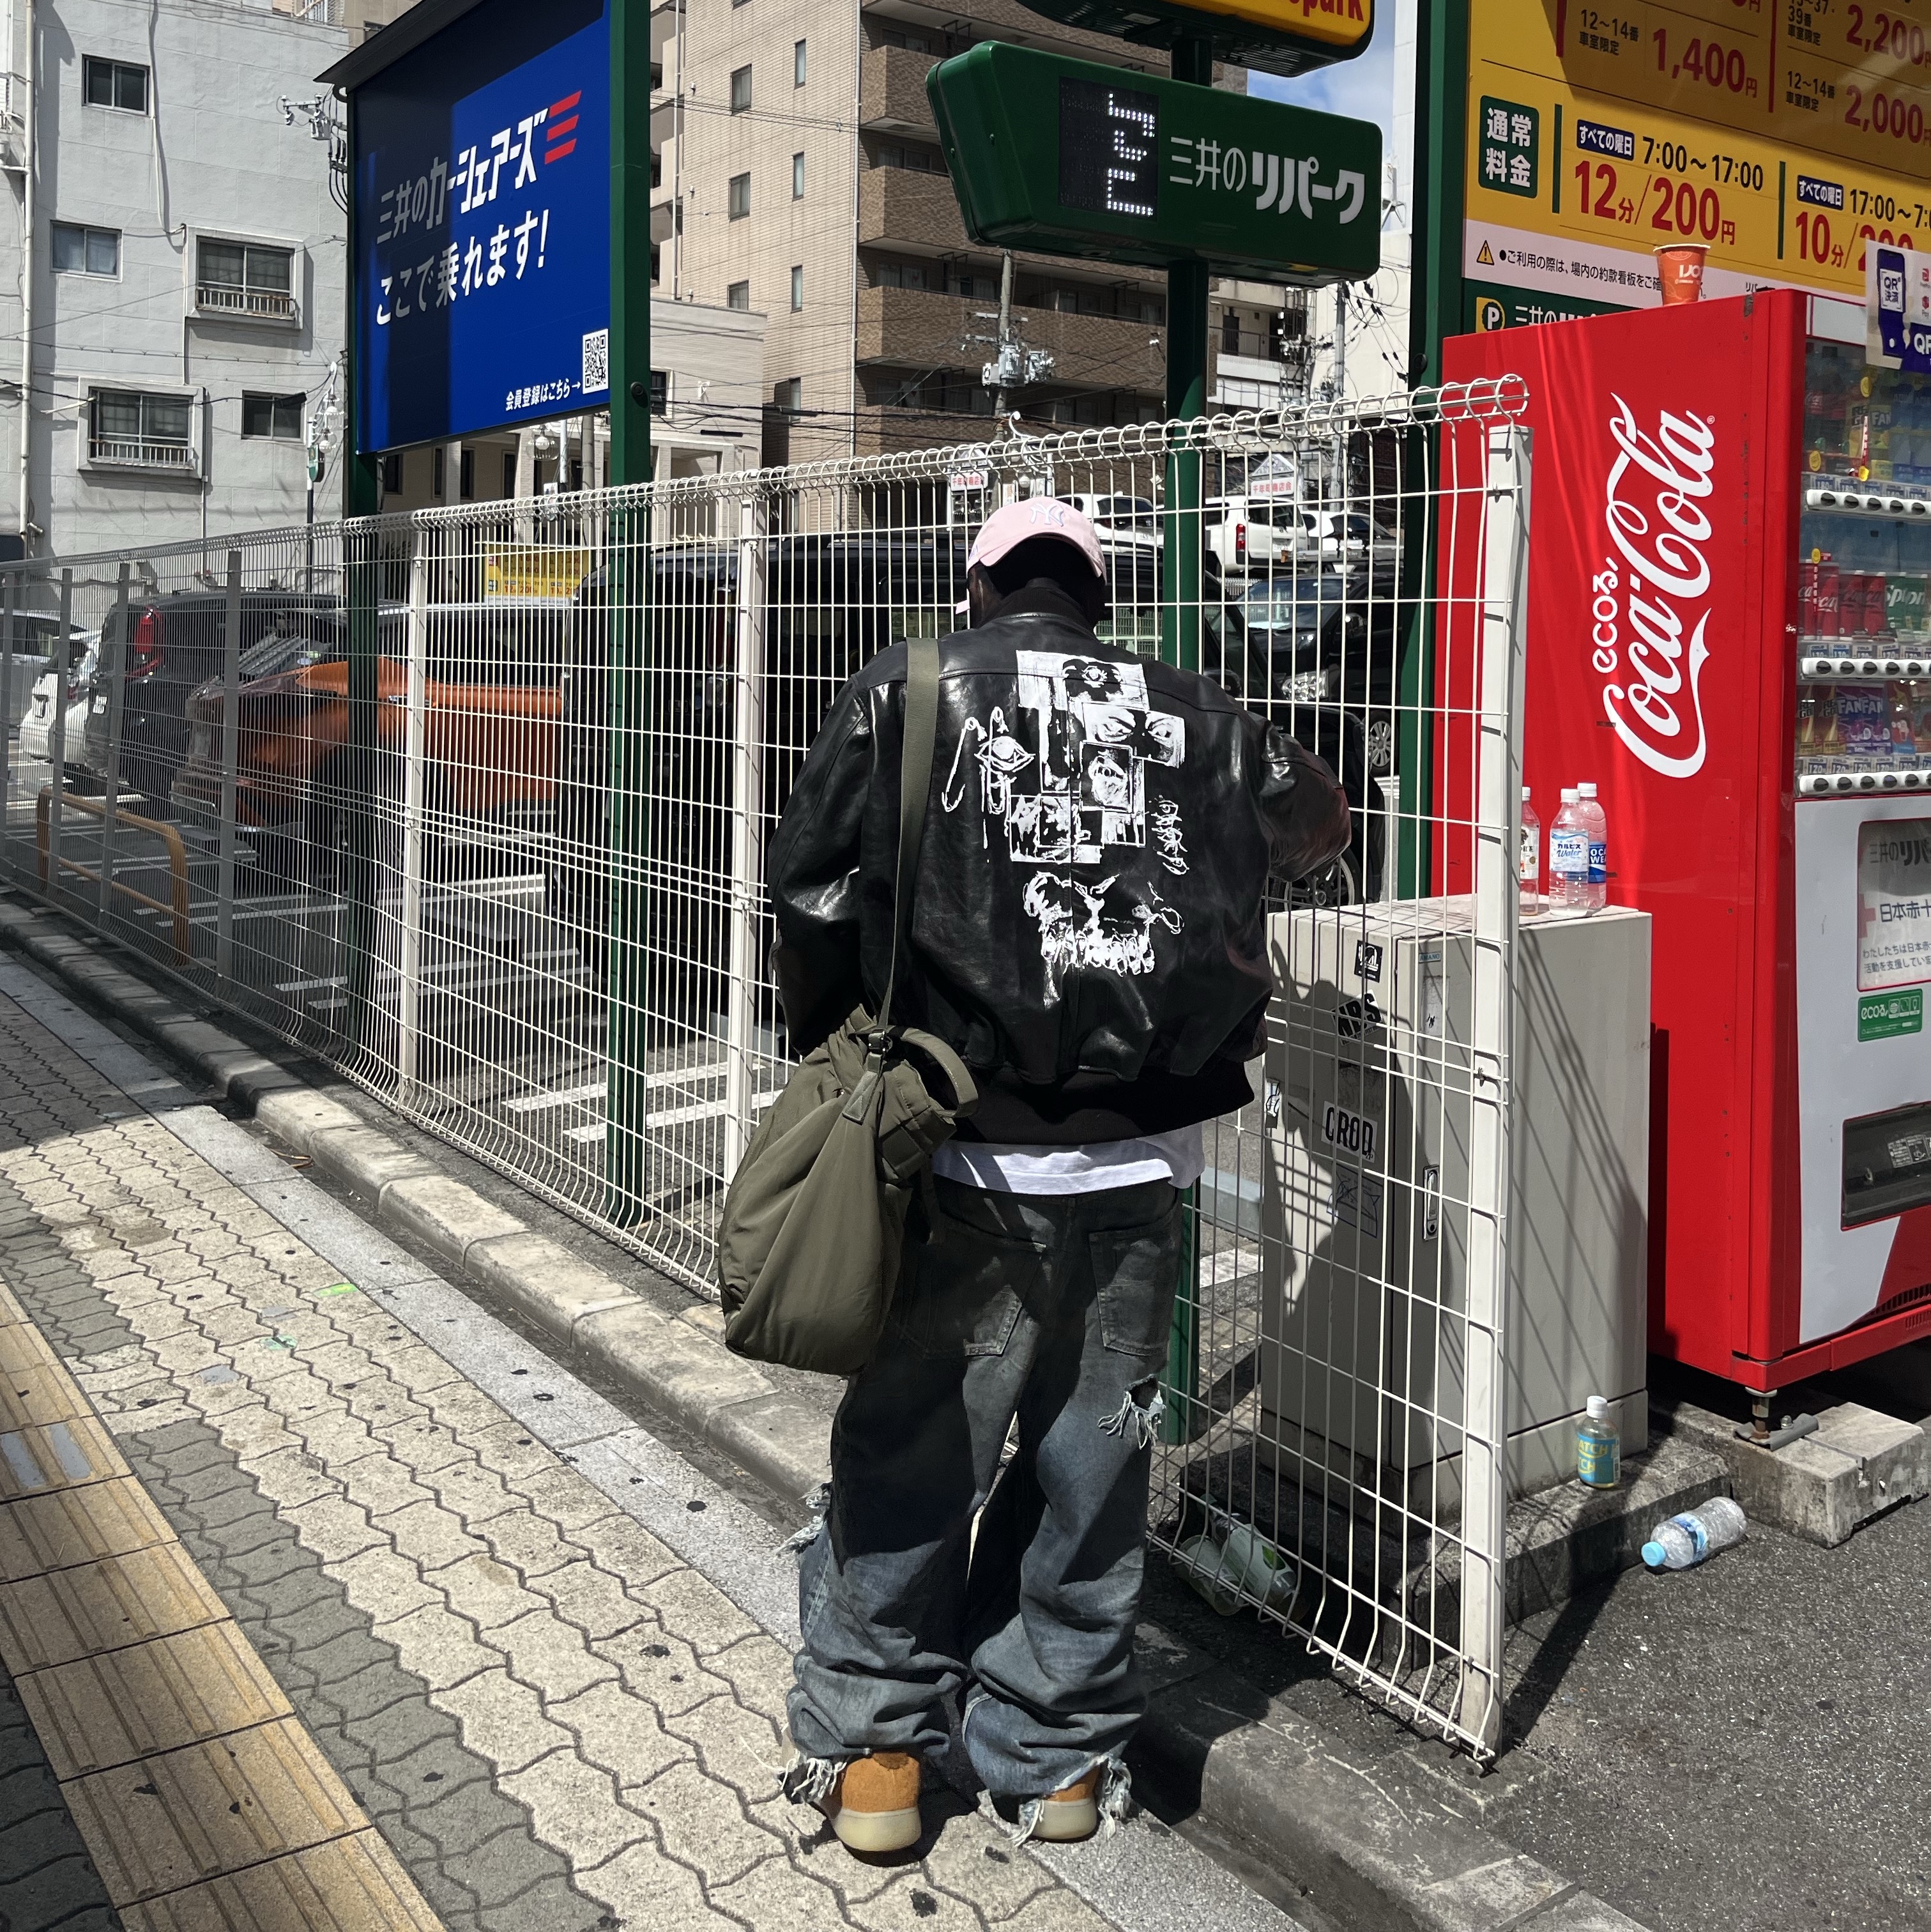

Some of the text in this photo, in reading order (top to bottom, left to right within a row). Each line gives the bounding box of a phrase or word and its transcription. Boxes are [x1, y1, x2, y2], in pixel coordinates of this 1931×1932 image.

[1653, 28, 1757, 98] 1,400円
[1487, 107, 1532, 147] 通常
[1579, 125, 1633, 157] すべての曜日
[377, 108, 549, 245] 三井のカーシェアーズ
[1170, 137, 1365, 224] 三井のリパーク
[1486, 148, 1531, 188] 料金
[1799, 180, 1842, 206] すべての曜日
[1029, 502, 1064, 527] NY
[1603, 392, 1715, 779] Coca-Cola
